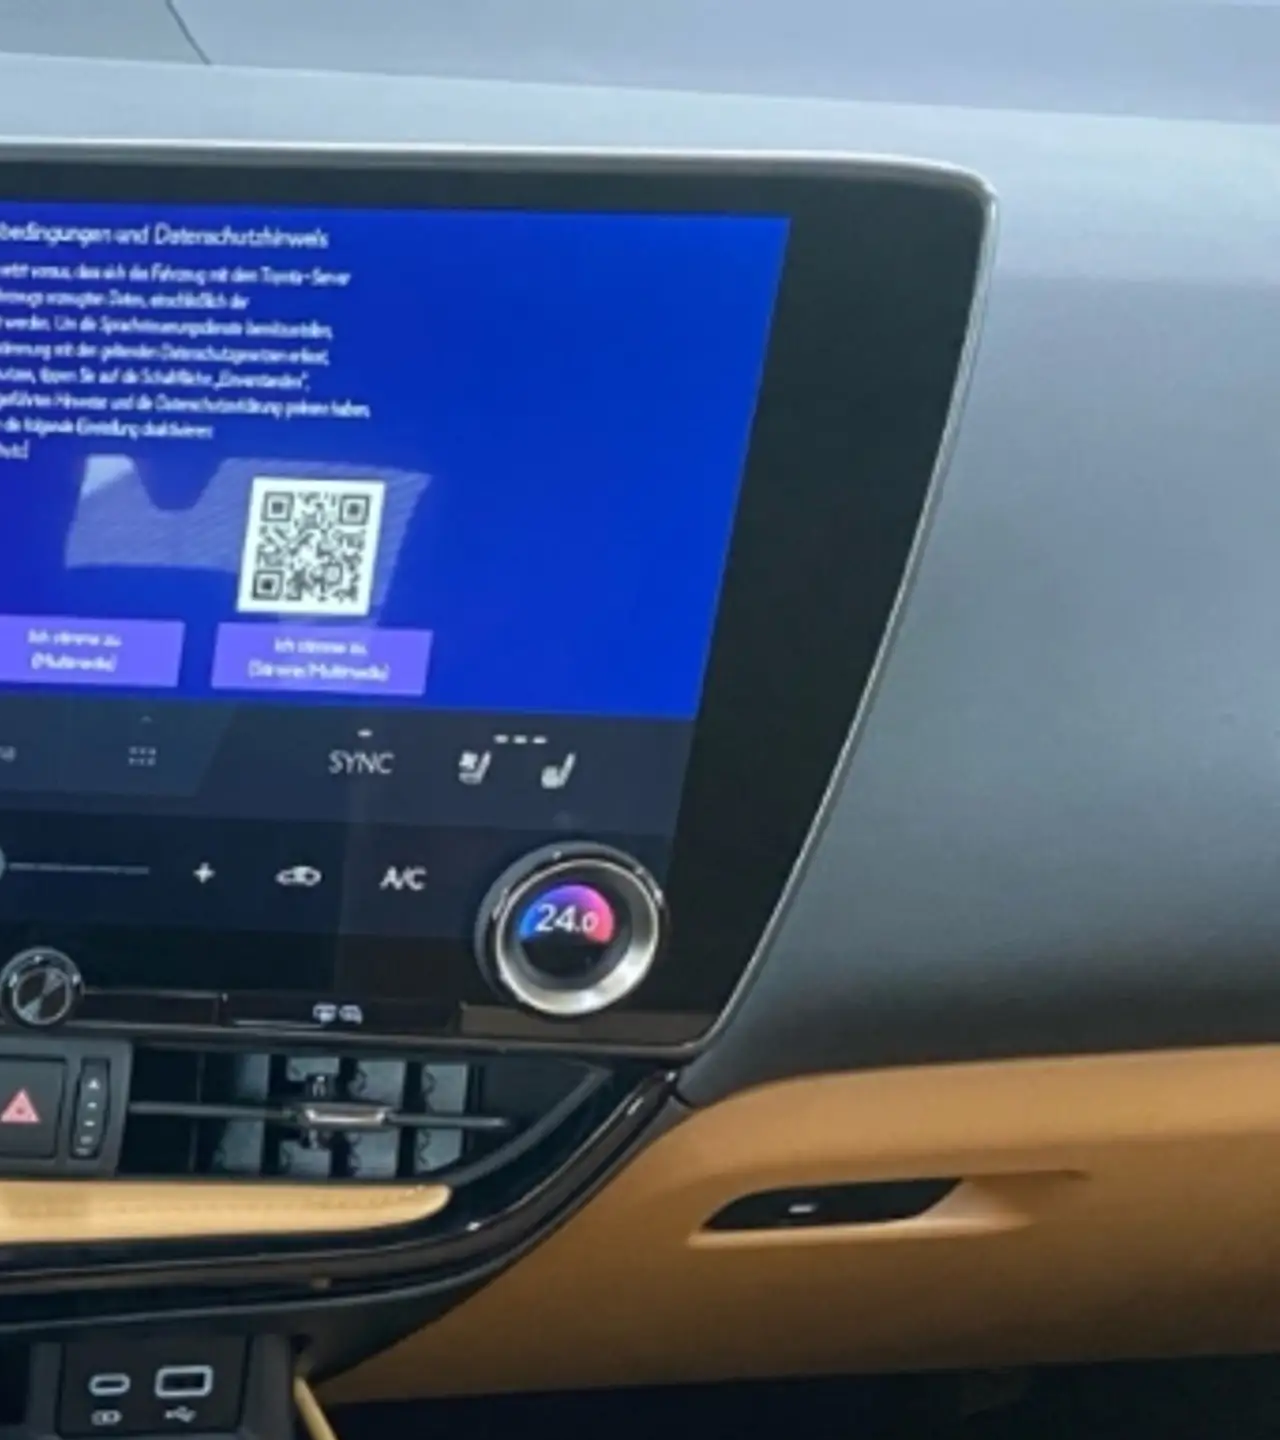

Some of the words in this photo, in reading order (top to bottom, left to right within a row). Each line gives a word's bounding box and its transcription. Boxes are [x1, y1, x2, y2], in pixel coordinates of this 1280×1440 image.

[115, 224, 150, 245] und
[328, 750, 396, 775] SYNC
[380, 866, 427, 891] A/C
[534, 904, 600, 933] 24.0
